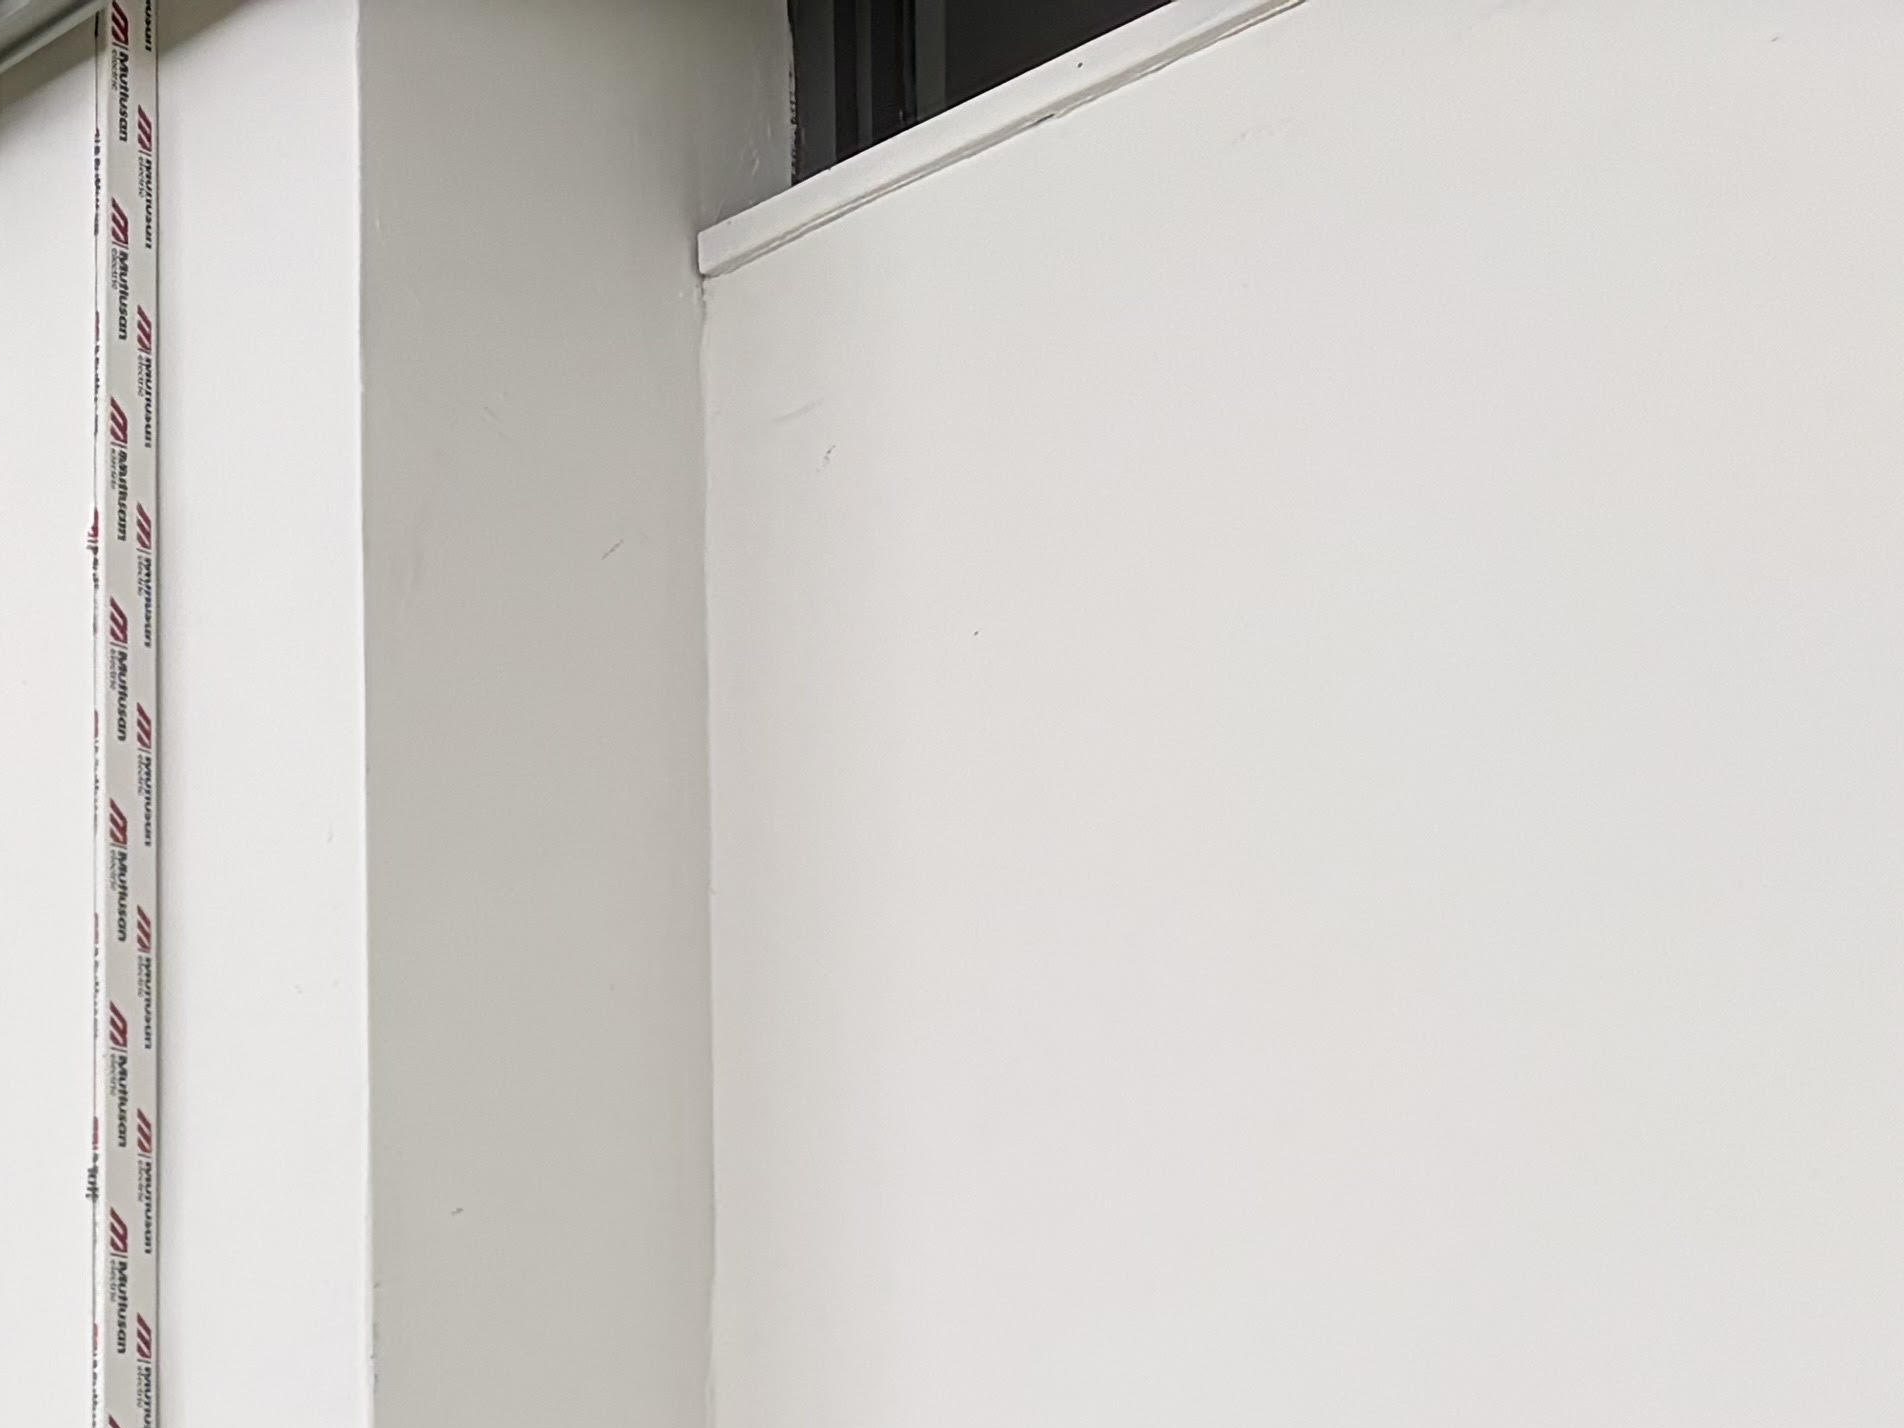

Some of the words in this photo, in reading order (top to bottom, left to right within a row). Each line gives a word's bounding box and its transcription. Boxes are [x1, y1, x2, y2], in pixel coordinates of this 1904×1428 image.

[119, 51, 130, 142] Mutlusan
[118, 249, 129, 341] Mutlusan
[116, 651, 128, 743] Mutlusan
[116, 851, 127, 942] Mutlusan
[117, 1054, 128, 1149] Mutlusan
[116, 1261, 127, 1355] Mutlusan
